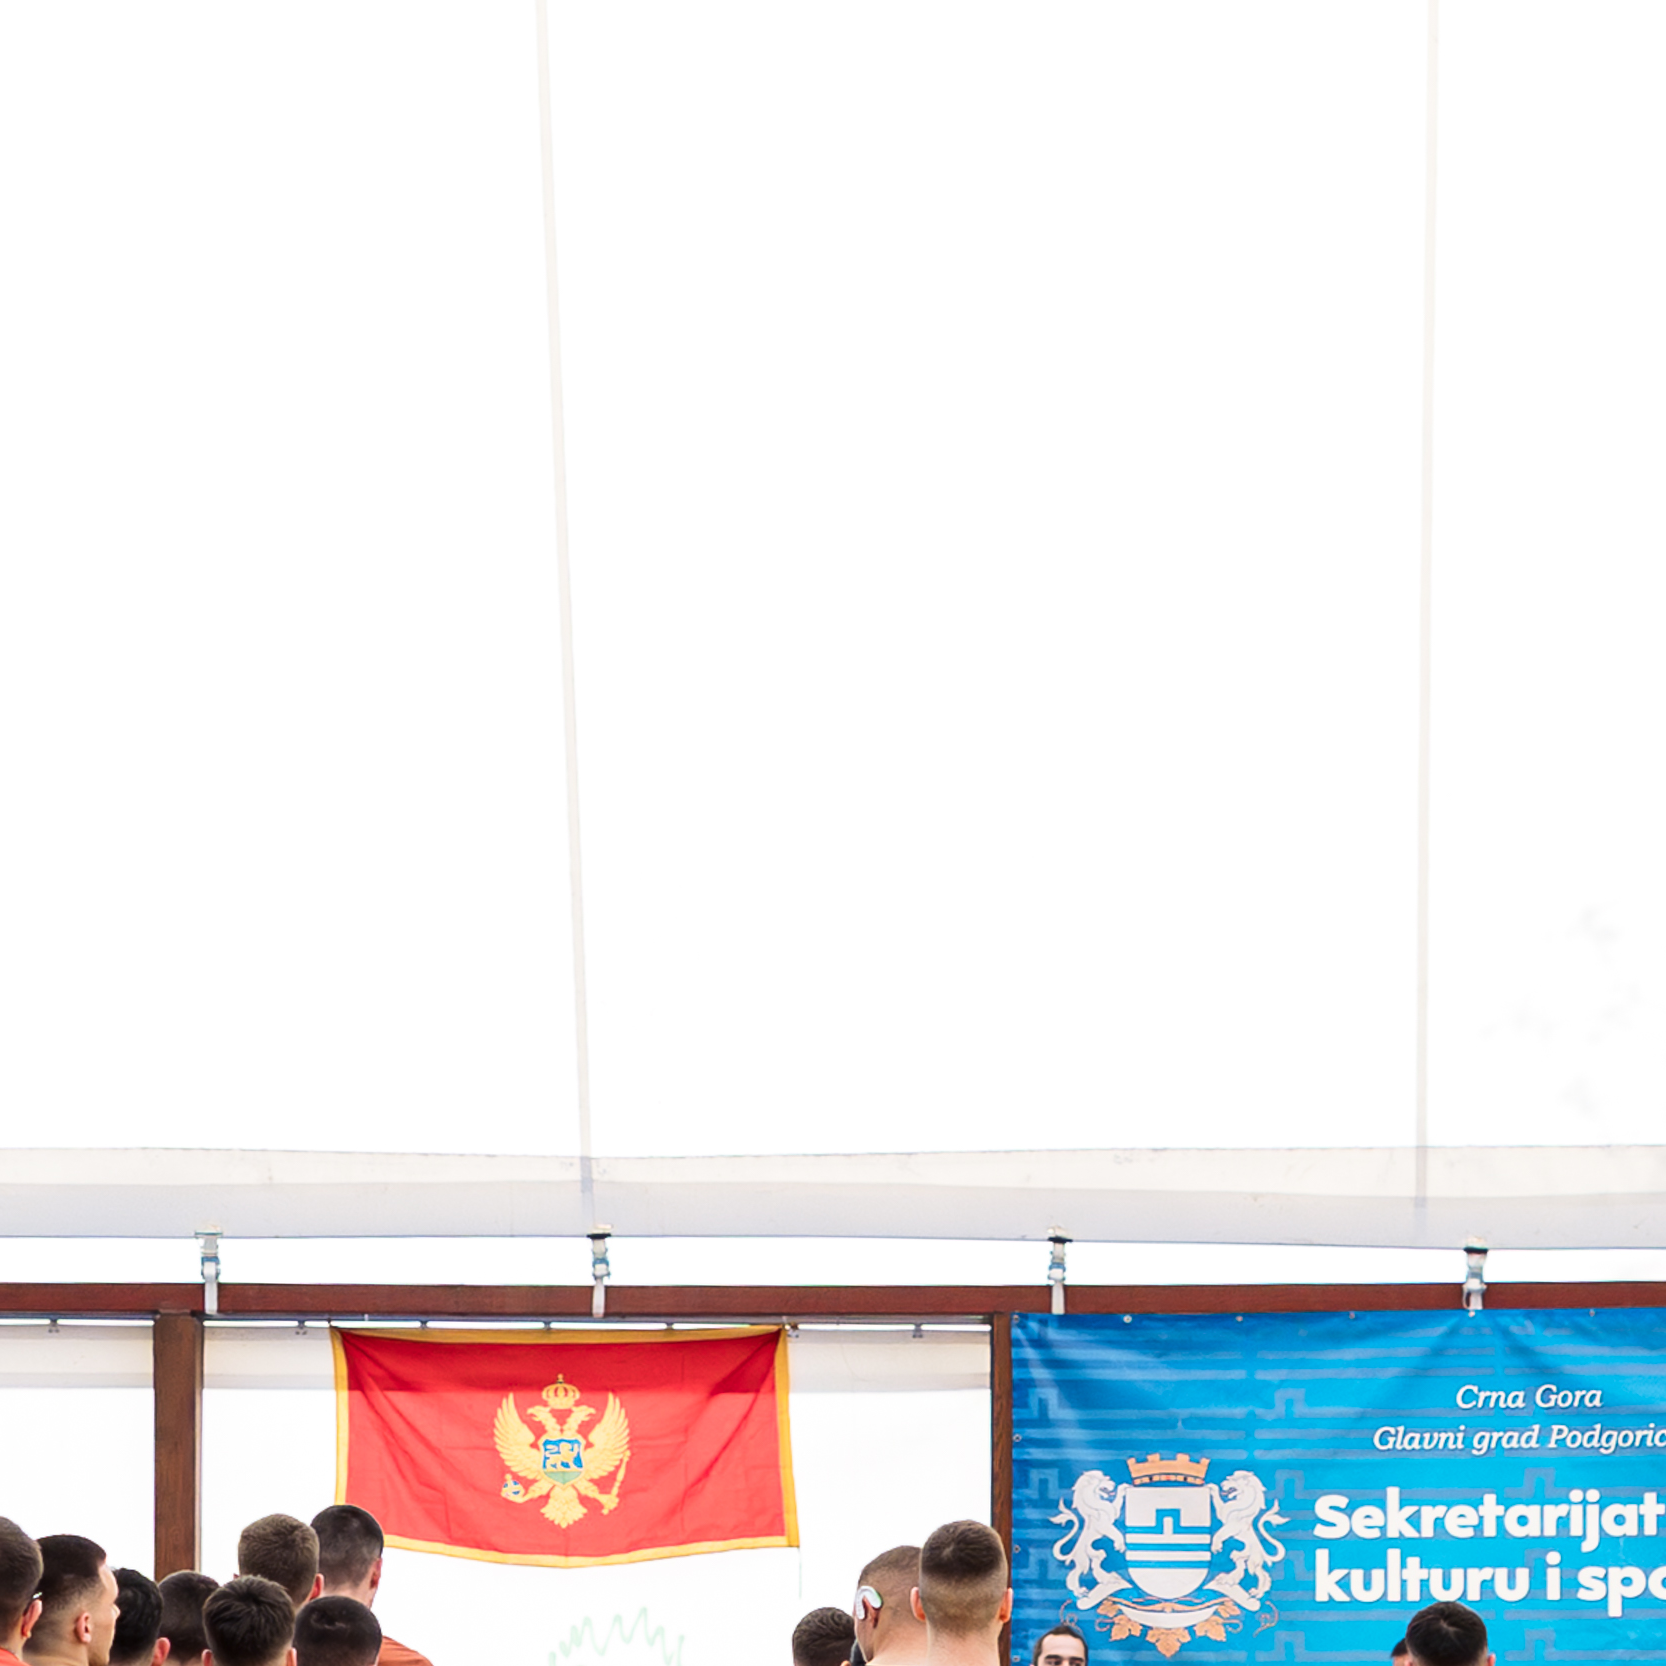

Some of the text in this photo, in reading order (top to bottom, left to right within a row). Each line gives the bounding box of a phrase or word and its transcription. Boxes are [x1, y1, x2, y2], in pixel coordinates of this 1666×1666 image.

[1456, 1384, 1603, 1409] Crna Gora
[1373, 1424, 1466, 1451] Glavni
[1471, 1424, 1541, 1455] grad
[1313, 1486, 1665, 1553] Sekretarijat
[1314, 1548, 1531, 1603] kulturu
[1545, 1551, 1562, 1601] i
